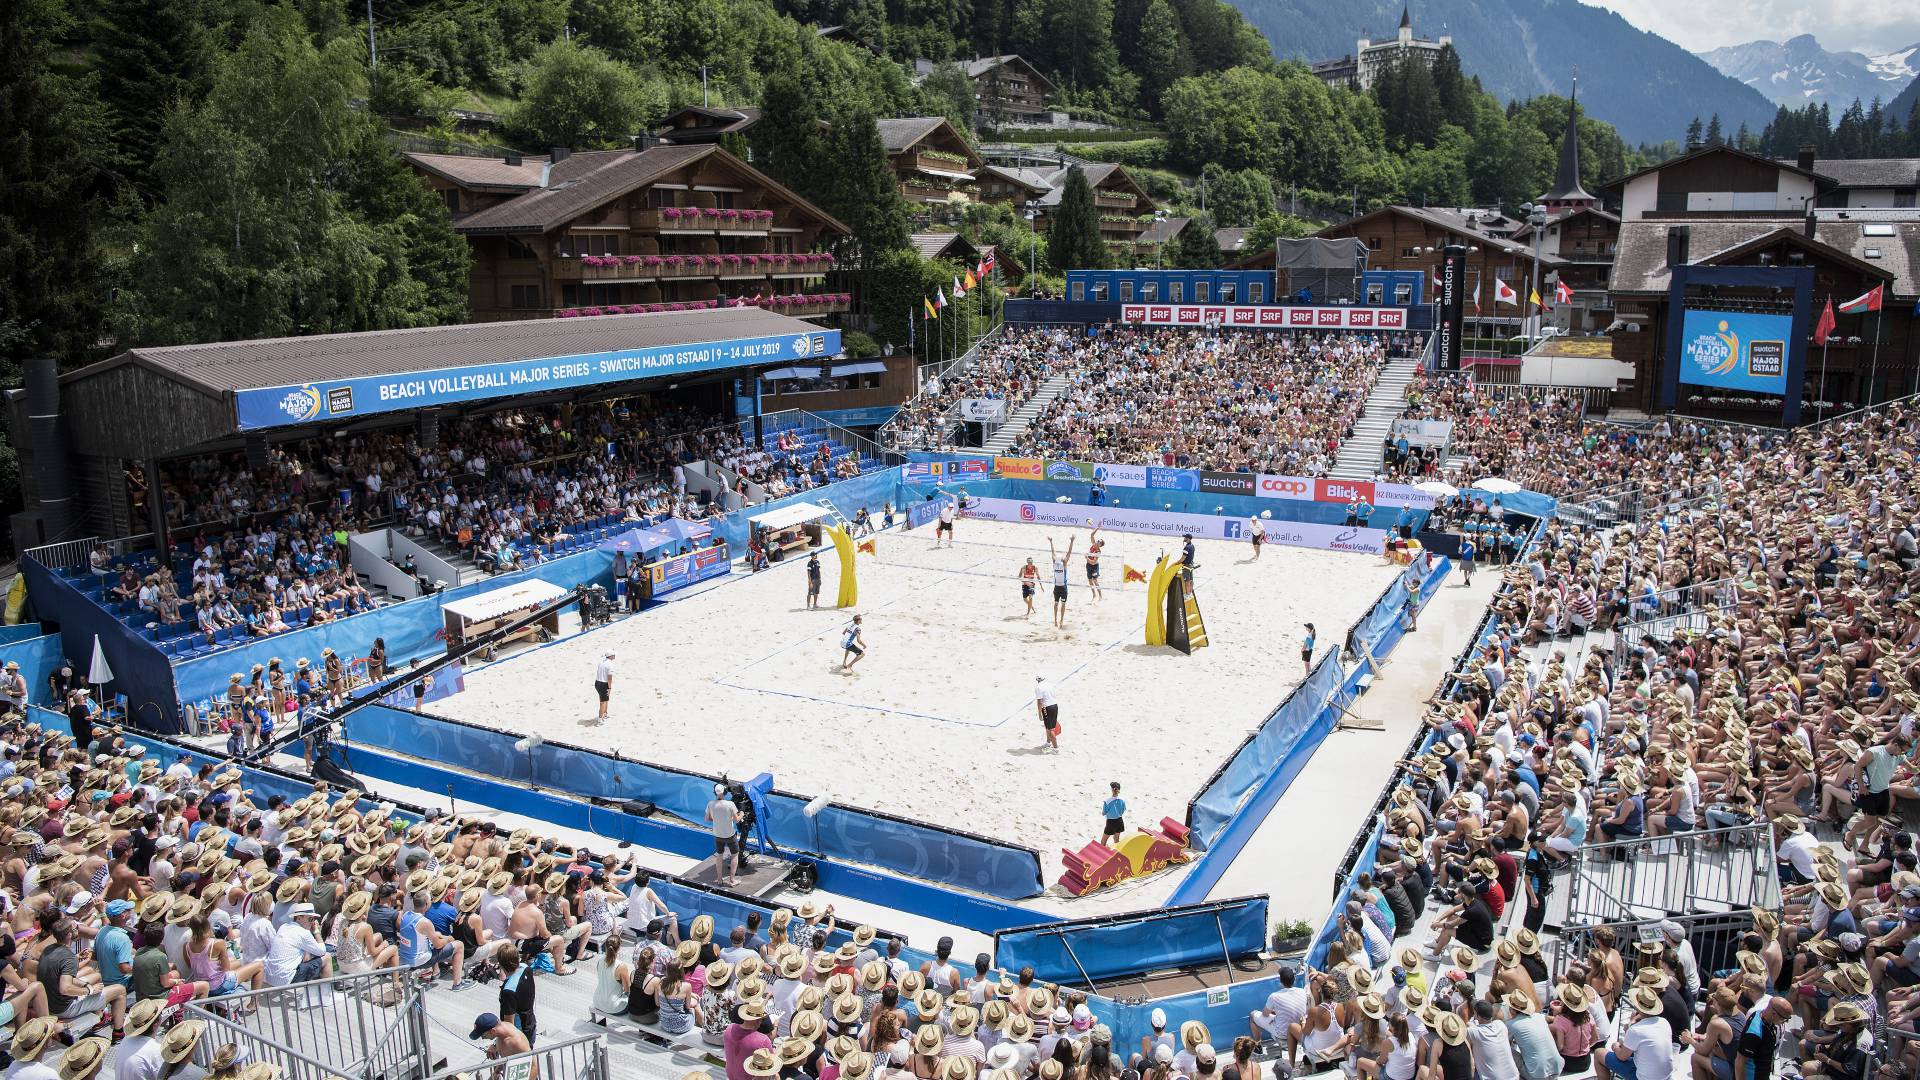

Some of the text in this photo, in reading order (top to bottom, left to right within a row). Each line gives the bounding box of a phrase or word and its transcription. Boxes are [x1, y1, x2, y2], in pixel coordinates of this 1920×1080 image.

[1445, 265, 1453, 305] swatch
[1127, 310, 1144, 318] SRF
[1152, 311, 1169, 319] SRF
[1180, 311, 1198, 319] SRF
[1235, 312, 1253, 320] SRF
[1262, 312, 1280, 320] SRF
[1293, 313, 1311, 321] SRF
[1320, 313, 1339, 322] SRF
[1352, 314, 1370, 322] SRF
[1381, 315, 1400, 323] SRF
[1441, 328, 1449, 367] swatch
[1688, 344, 1728, 357] MAJOR
[1694, 355, 1720, 363] SERIES
[379, 381, 425, 400] BEACH
[429, 372, 507, 394] VOLLEYBALL
[510, 367, 550, 385] MAJOR
[552, 362, 589, 380] SERIES
[600, 356, 640, 373] SWATCH
[643, 353, 674, 368] MAJOR
[676, 350, 710, 364] GSTAAD
[717, 348, 722, 360] 9
[730, 347, 740, 358] 14
[742, 345, 760, 357] JULY
[762, 342, 780, 355] 2019
[280, 398, 313, 410] MAJOR
[287, 406, 308, 414] SERIES
[996, 461, 1029, 474] Sinalco
[1202, 478, 1245, 488] swatch
[1262, 480, 1307, 495] coop
[1327, 485, 1358, 498] Blick
[1036, 514, 1078, 524] swiss.volley
[1102, 519, 1126, 527] Follow
[1152, 522, 1174, 531] Social
[1176, 524, 1204, 533] Media!
